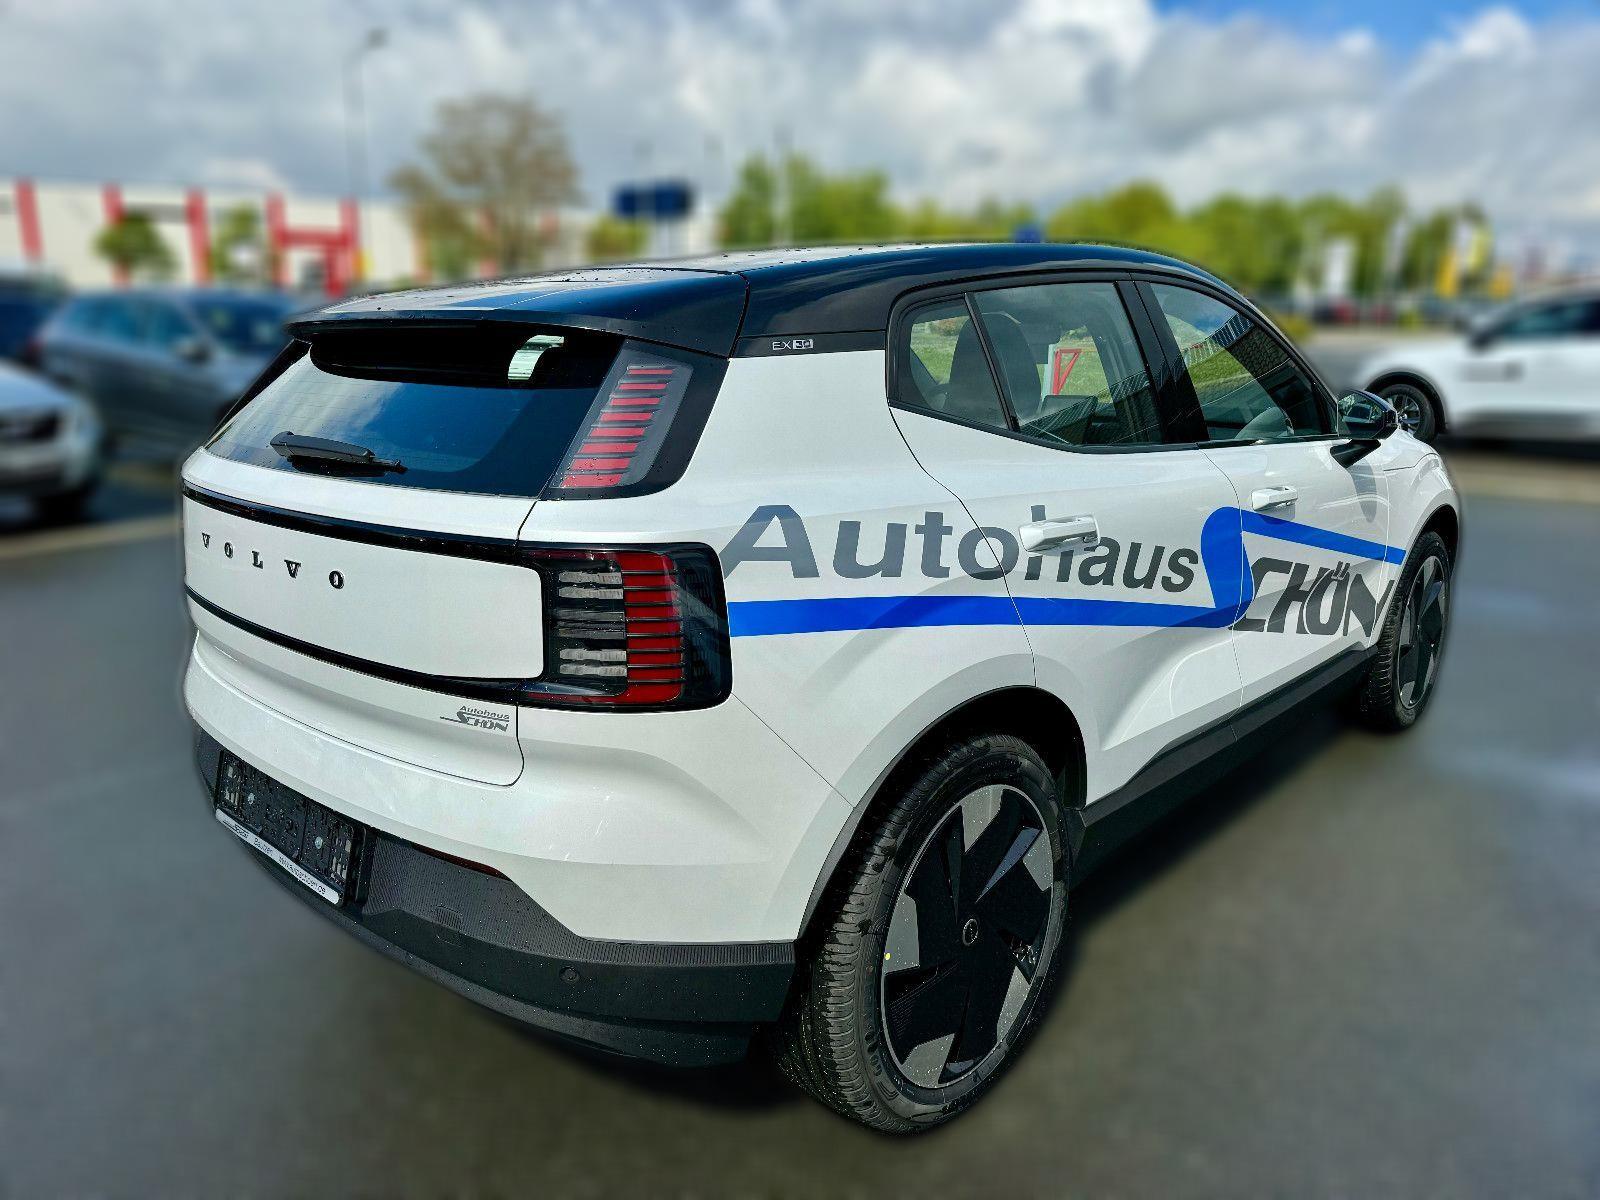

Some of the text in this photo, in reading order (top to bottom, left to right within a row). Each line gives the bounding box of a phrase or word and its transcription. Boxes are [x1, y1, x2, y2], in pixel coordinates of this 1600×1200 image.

[201, 532, 345, 590] VOLVO
[718, 504, 1199, 593] Autohaus
[459, 705, 510, 720] Autohaus
